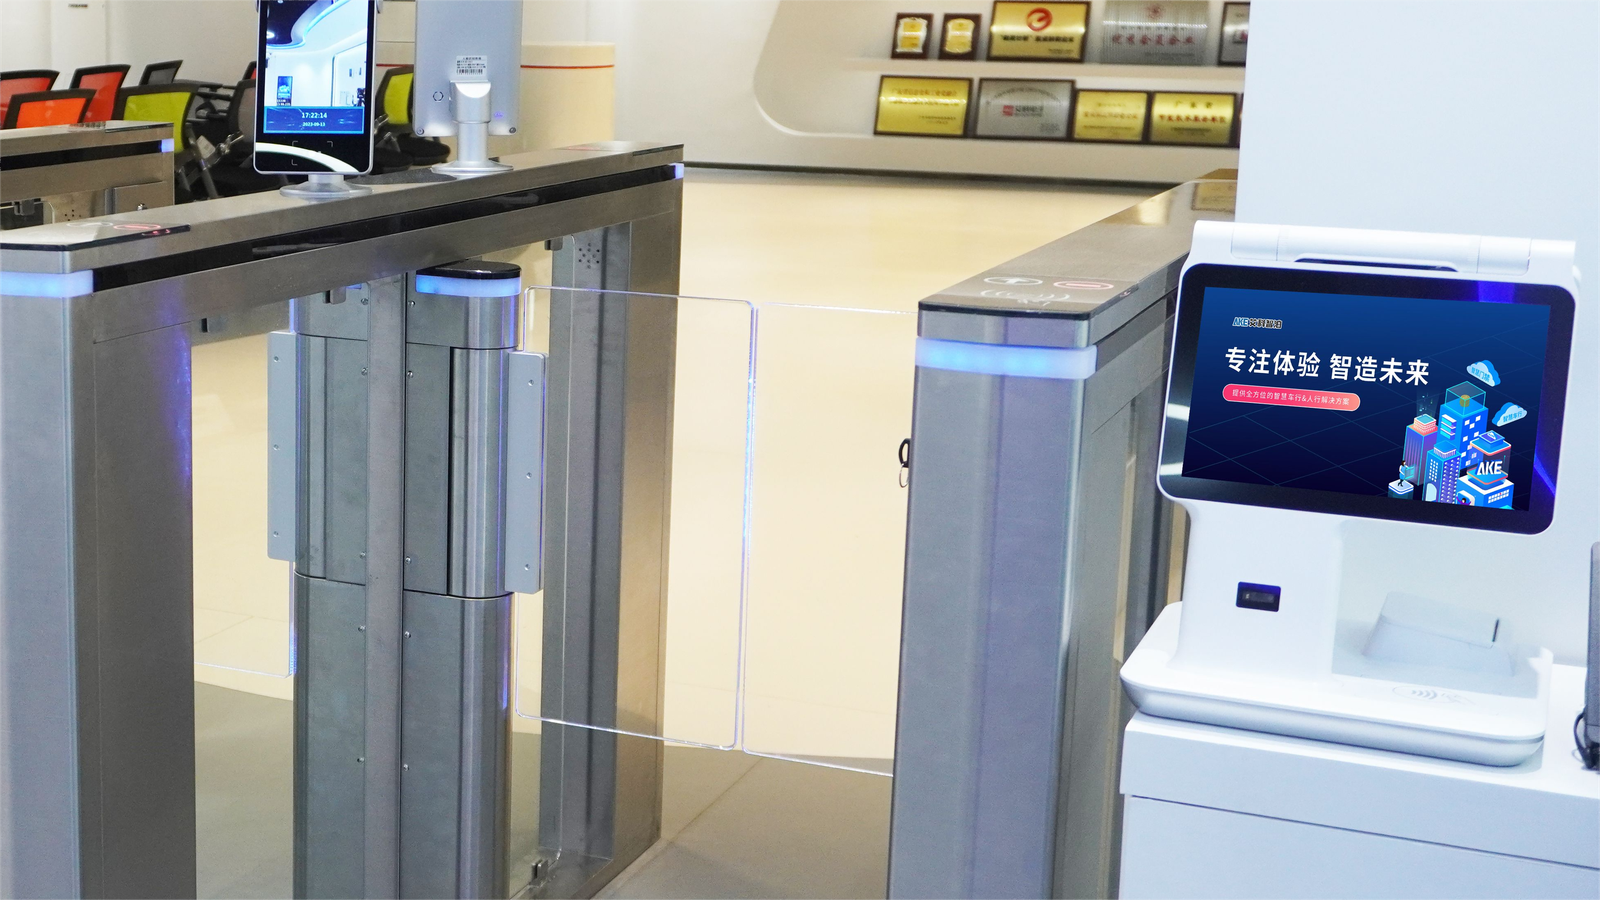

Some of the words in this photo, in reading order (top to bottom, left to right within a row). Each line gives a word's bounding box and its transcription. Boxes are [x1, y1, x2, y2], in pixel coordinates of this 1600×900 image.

[1225, 346, 1321, 378] 专注体验
[1329, 353, 1430, 386] 智造未来
[1231, 388, 1351, 406] 提供全方位的智慧车行&人行解决方案
[1476, 460, 1503, 476] AKE
